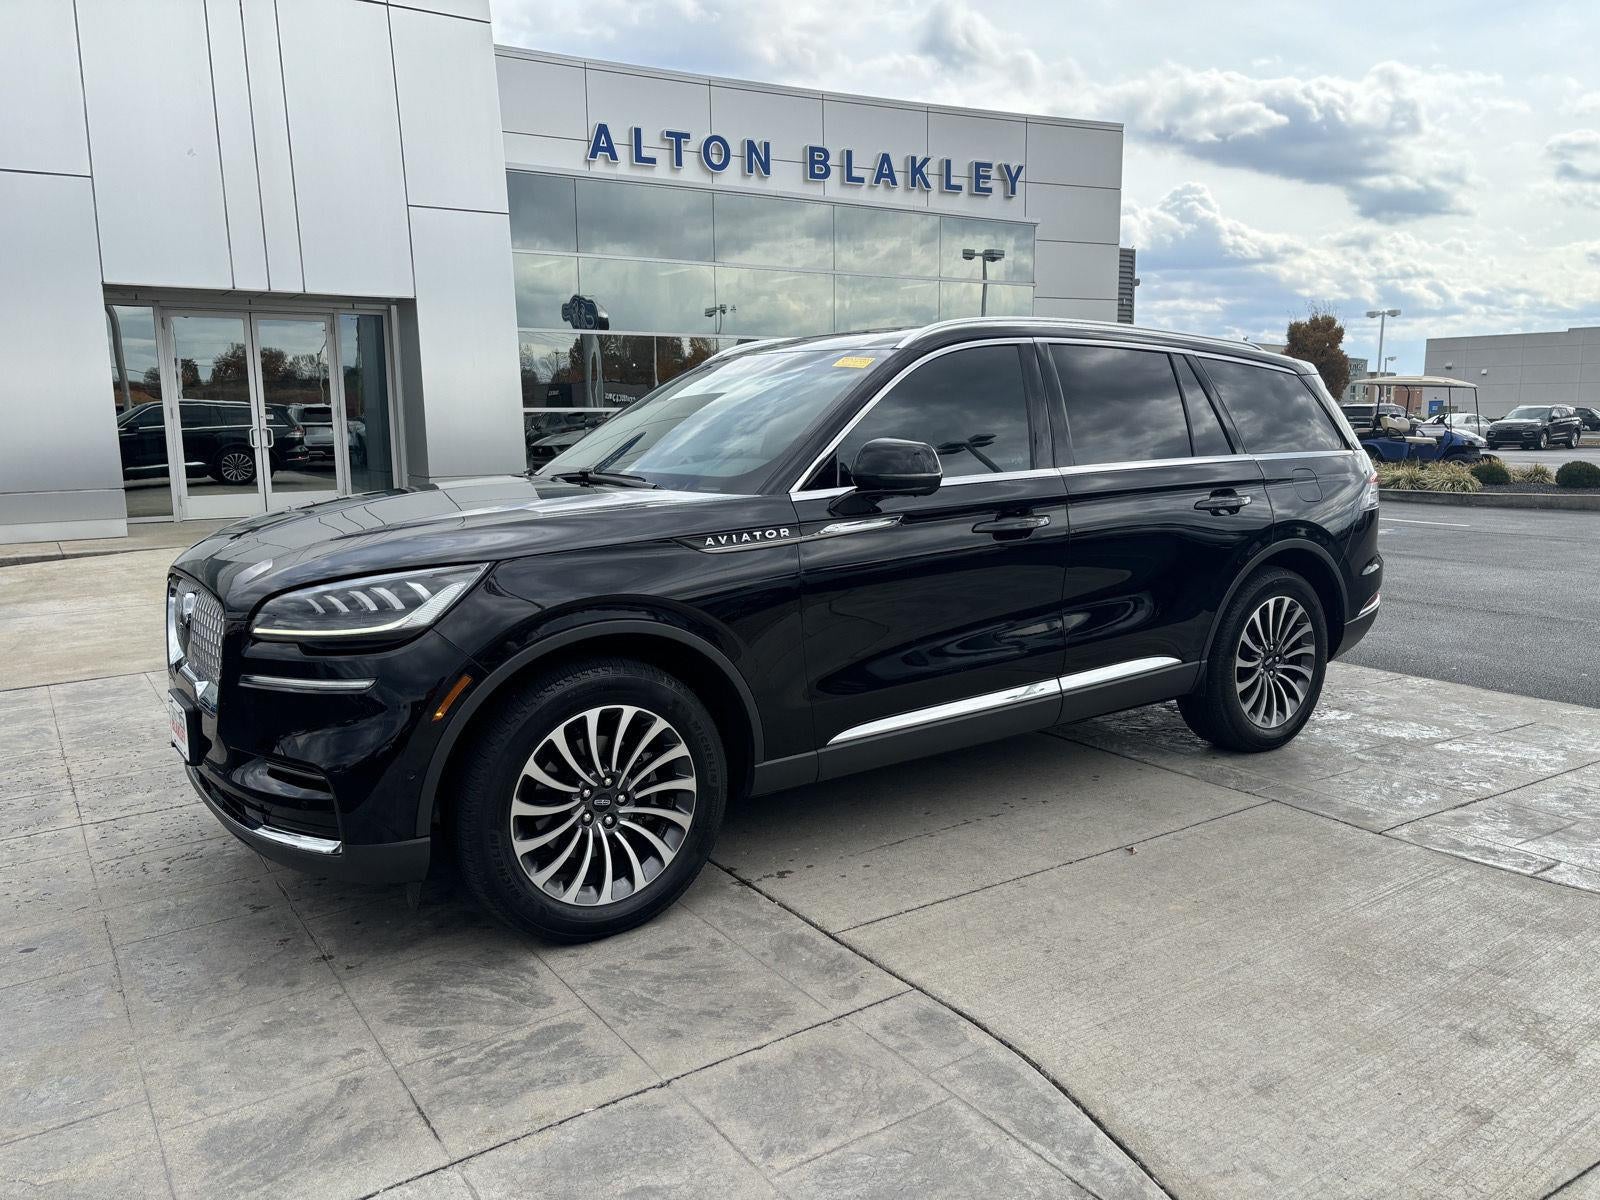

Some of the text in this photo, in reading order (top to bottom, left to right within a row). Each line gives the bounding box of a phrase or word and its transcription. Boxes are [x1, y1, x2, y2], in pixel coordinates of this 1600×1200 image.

[588, 121, 1024, 197] ALTON BLAKLEY
[704, 527, 791, 547] AVIATOR
